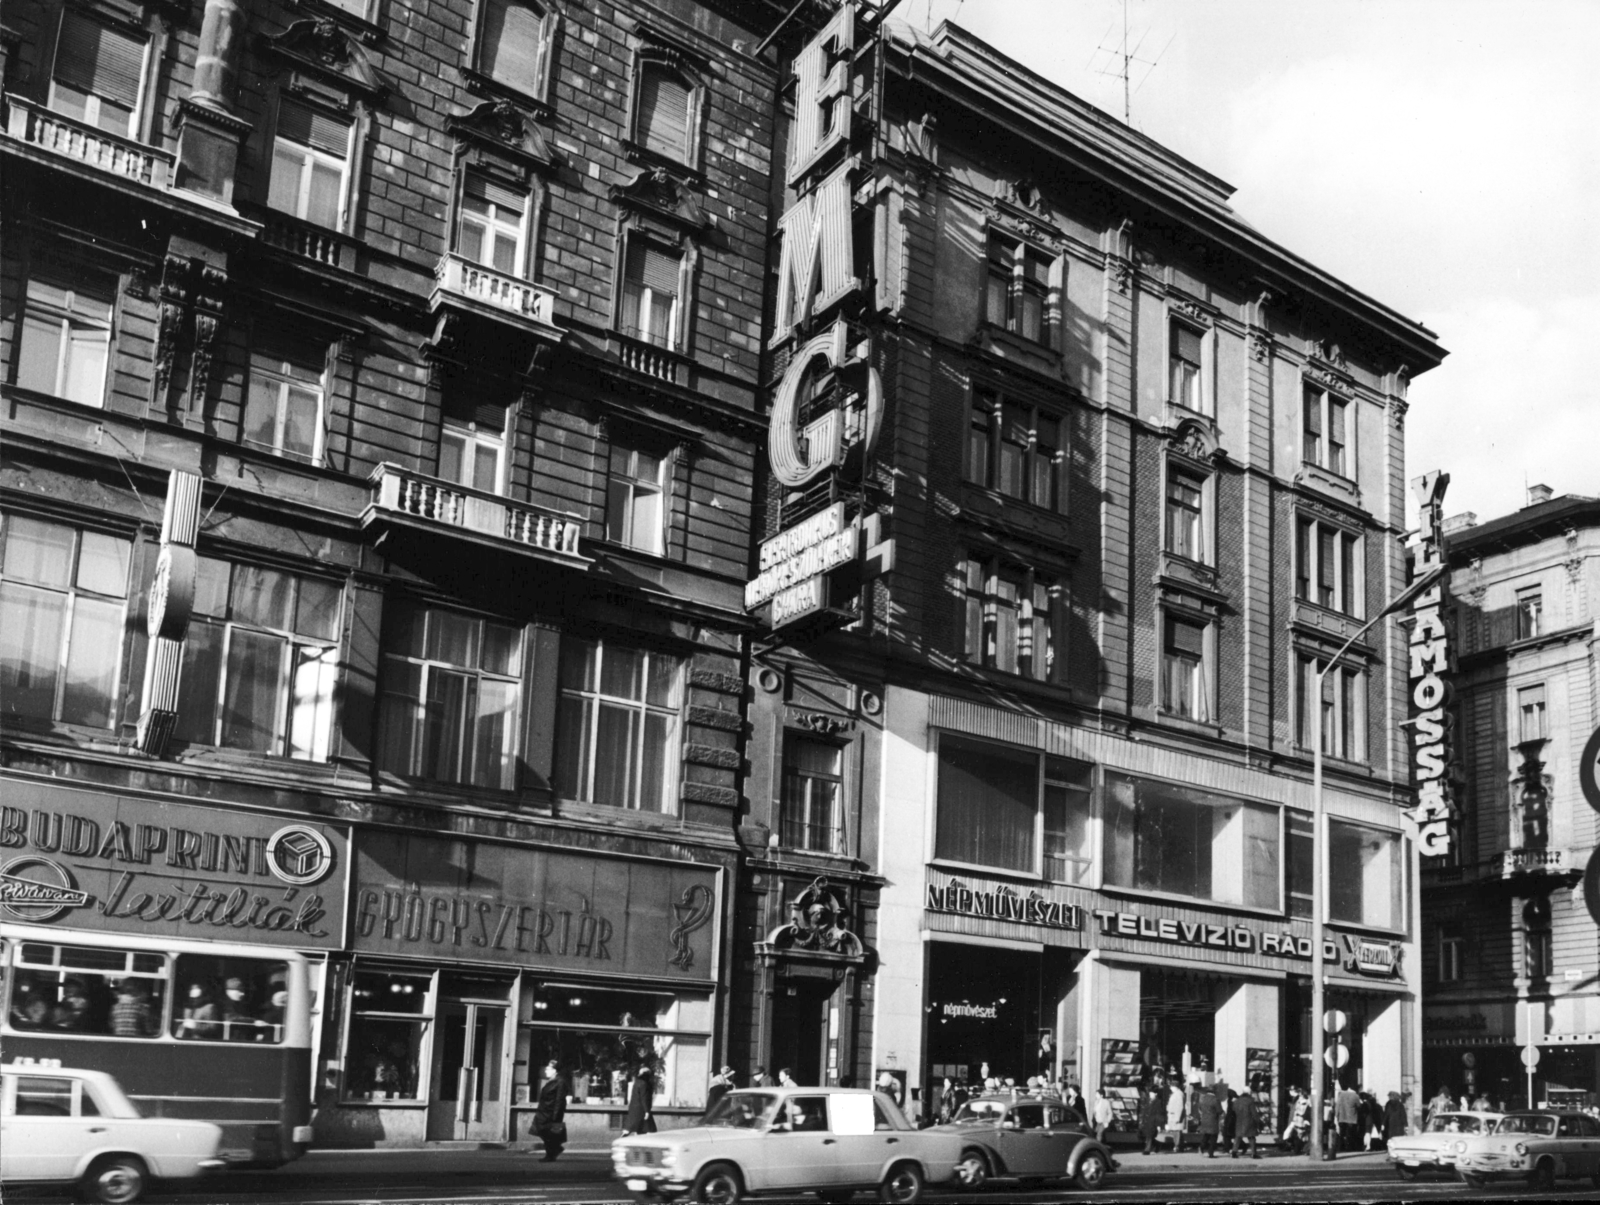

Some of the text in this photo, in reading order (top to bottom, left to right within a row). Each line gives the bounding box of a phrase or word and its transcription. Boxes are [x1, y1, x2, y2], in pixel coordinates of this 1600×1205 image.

[0, 806, 270, 875] BUDAPRINT
[355, 882, 613, 960] GYÓGYSZERTÁR
[925, 878, 1082, 928] NÉPMŰVÉSZET
[1095, 909, 1337, 960] TELEVIZIÓ RÁDÓ
